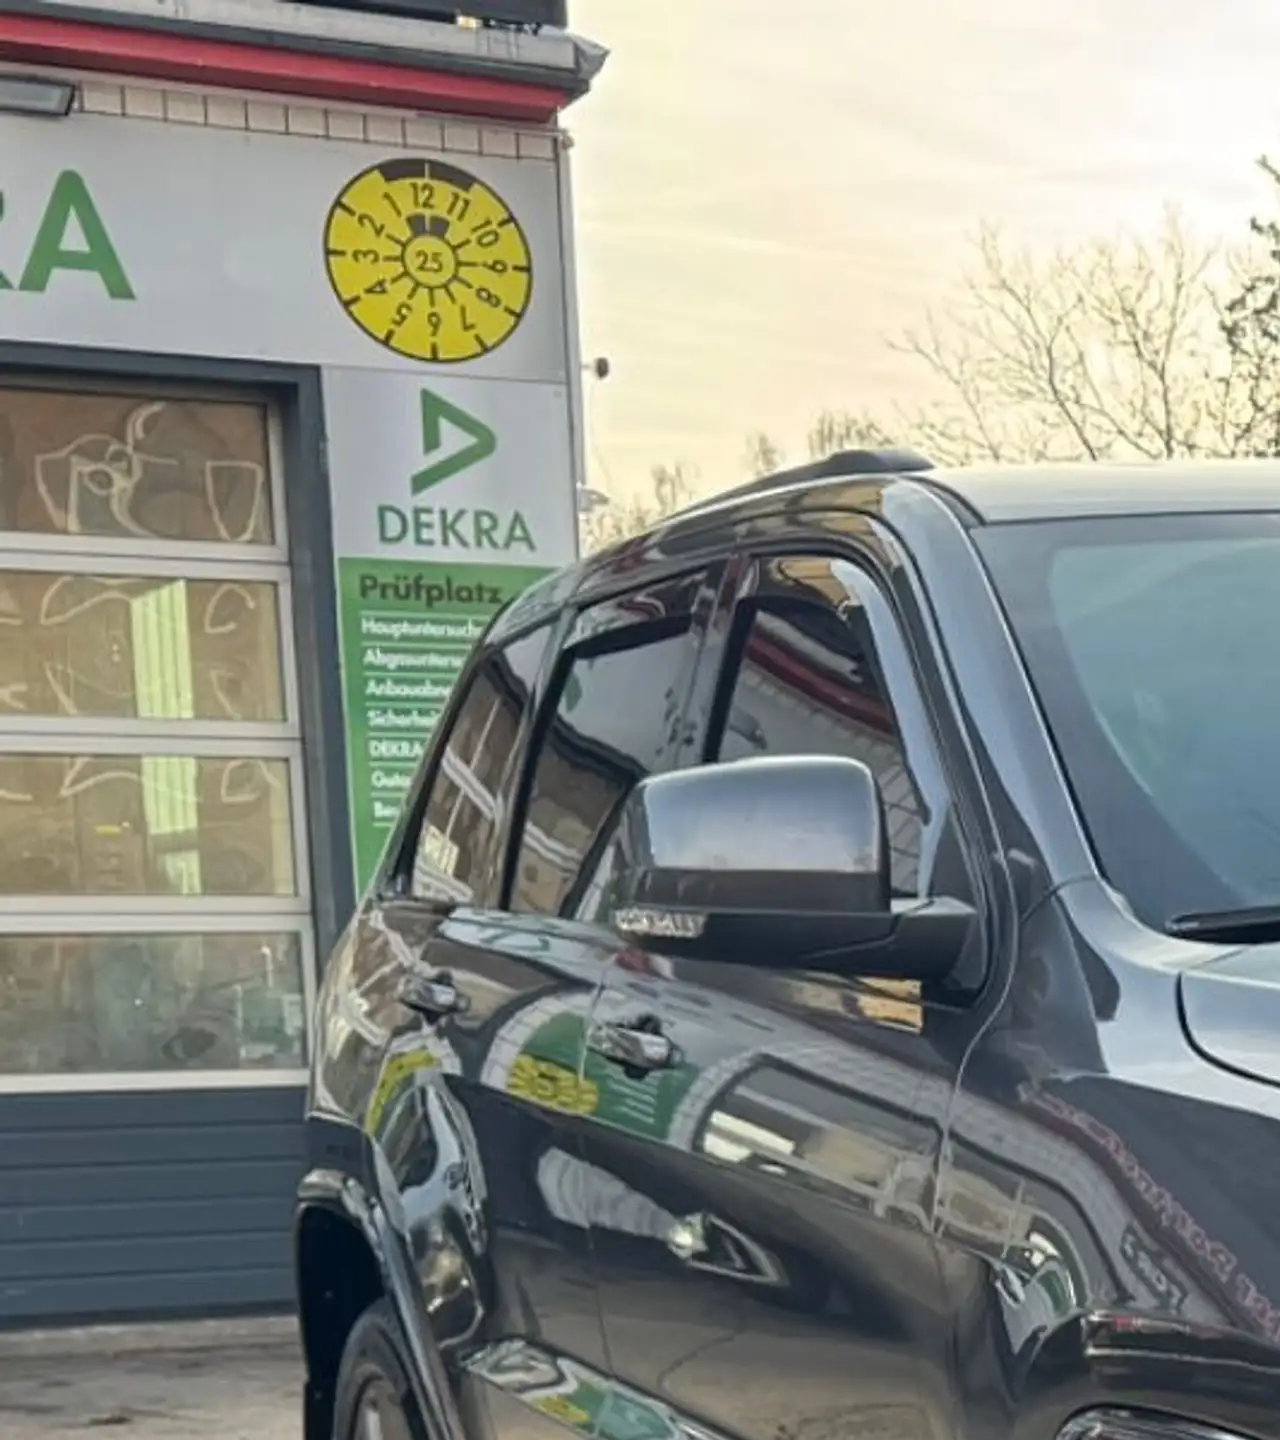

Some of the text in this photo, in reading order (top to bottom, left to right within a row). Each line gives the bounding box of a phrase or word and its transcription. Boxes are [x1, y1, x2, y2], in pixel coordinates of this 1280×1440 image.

[383, 191, 402, 219] 1
[410, 182, 434, 209] 12
[446, 191, 470, 222] 11
[357, 213, 385, 237] 2
[471, 219, 500, 248] 10
[352, 248, 379, 265] 3
[415, 250, 444, 273] 25
[363, 278, 388, 295] 4
[475, 287, 502, 308] 8
[391, 302, 413, 327] 5
[427, 311, 442, 337] 6
[460, 304, 475, 332] 7
[376, 504, 538, 552] DEKRA
[359, 573, 504, 610] Prüfplatz
